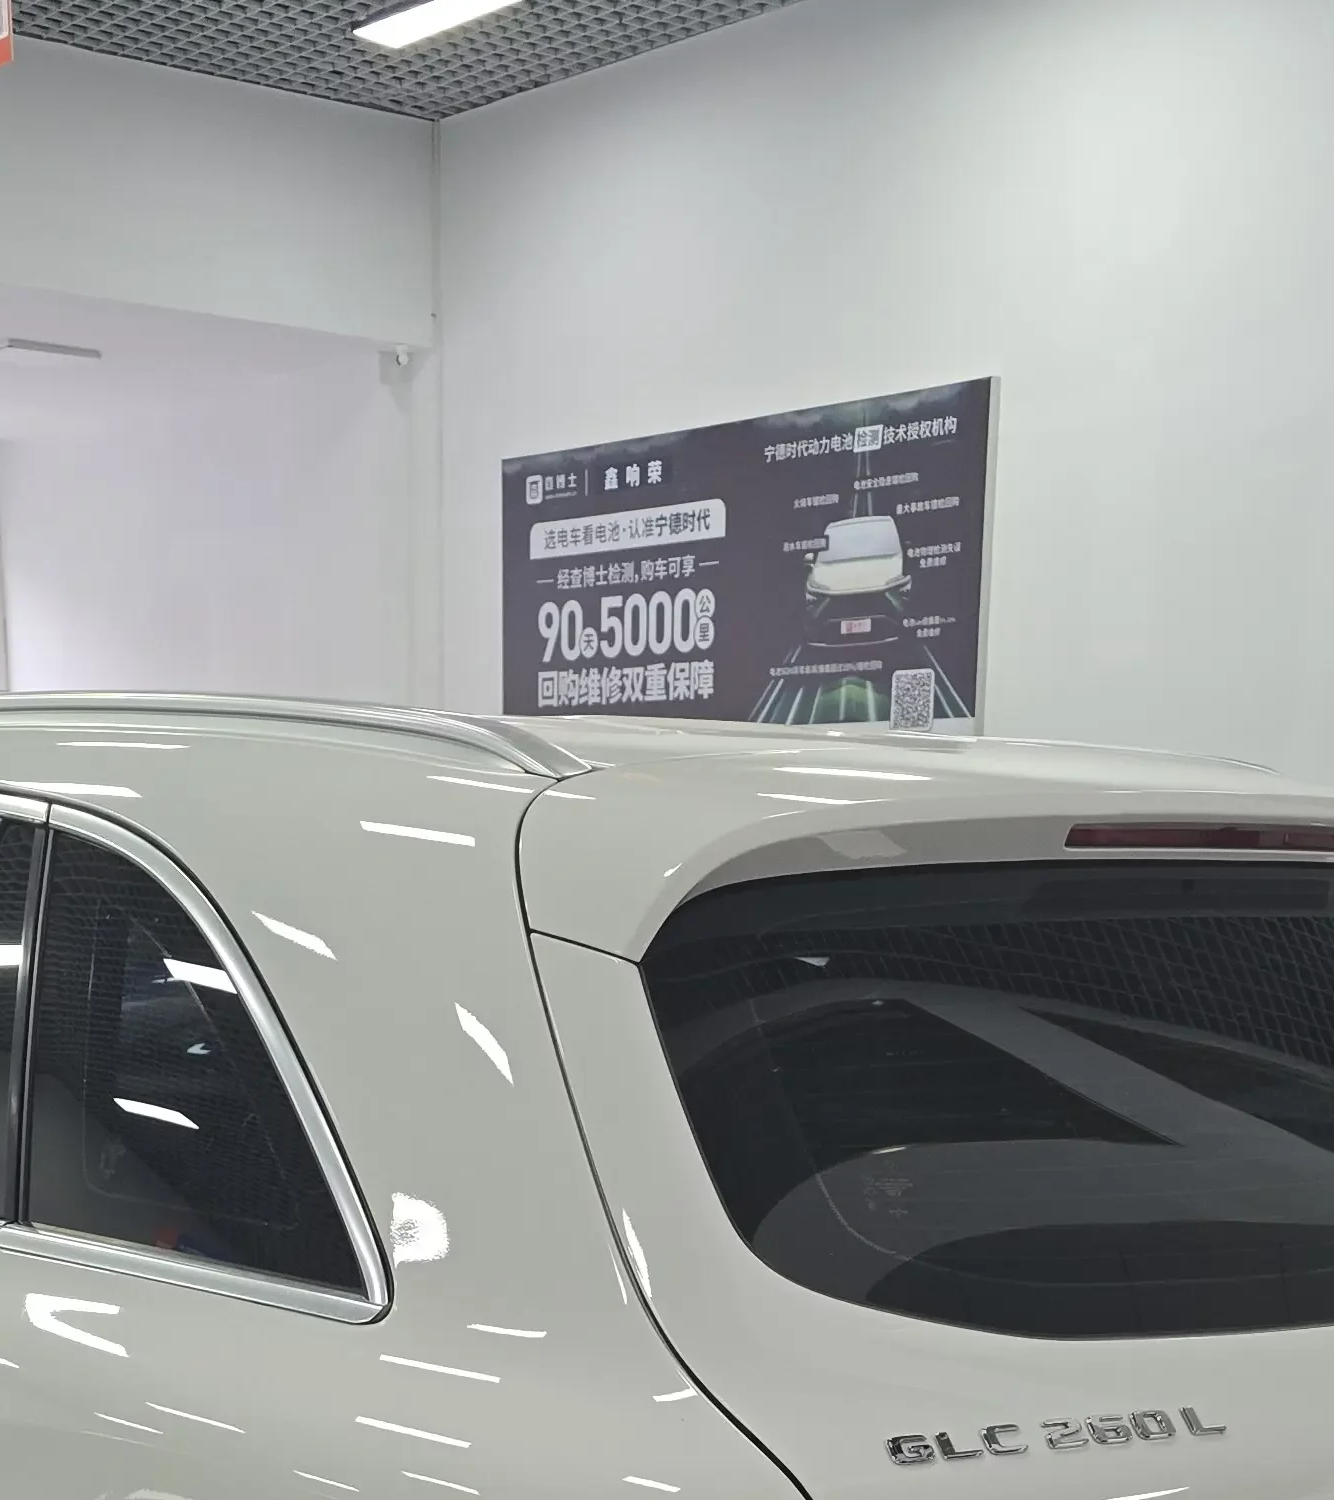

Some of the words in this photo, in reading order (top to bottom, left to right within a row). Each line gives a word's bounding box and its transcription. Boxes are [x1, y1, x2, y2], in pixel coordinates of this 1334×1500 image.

[603, 459, 664, 491] 鑫响荣
[537, 659, 715, 709] 回购维修双重保障
[885, 1422, 1030, 1466] GLC
